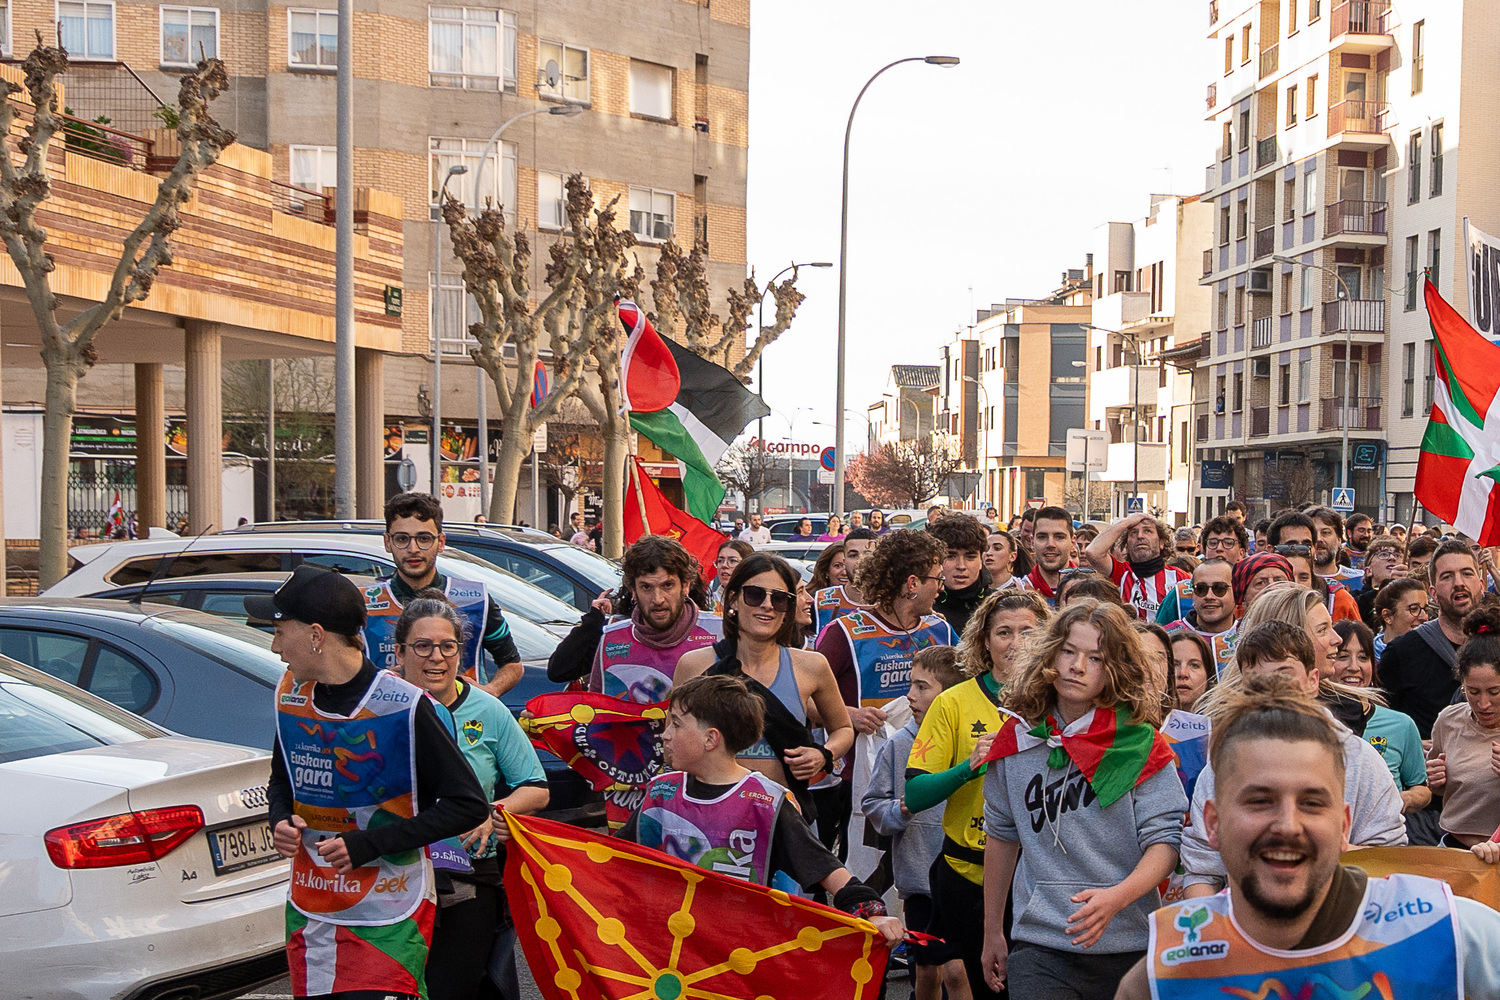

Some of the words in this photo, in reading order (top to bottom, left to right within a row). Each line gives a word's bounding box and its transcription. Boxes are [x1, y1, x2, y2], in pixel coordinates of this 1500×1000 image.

[460, 588, 482, 597] eitb
[383, 690, 410, 703] eitb
[1181, 720, 1206, 731] eitb
[290, 751, 333, 770] Euskara
[295, 766, 333, 788] gara
[218, 829, 257, 861] 7984
[181, 870, 197, 883] A4
[294, 869, 361, 894] 24.korrika
[374, 870, 411, 894] aek
[1384, 897, 1434, 924] eitb
[1166, 943, 1226, 961] goiener
